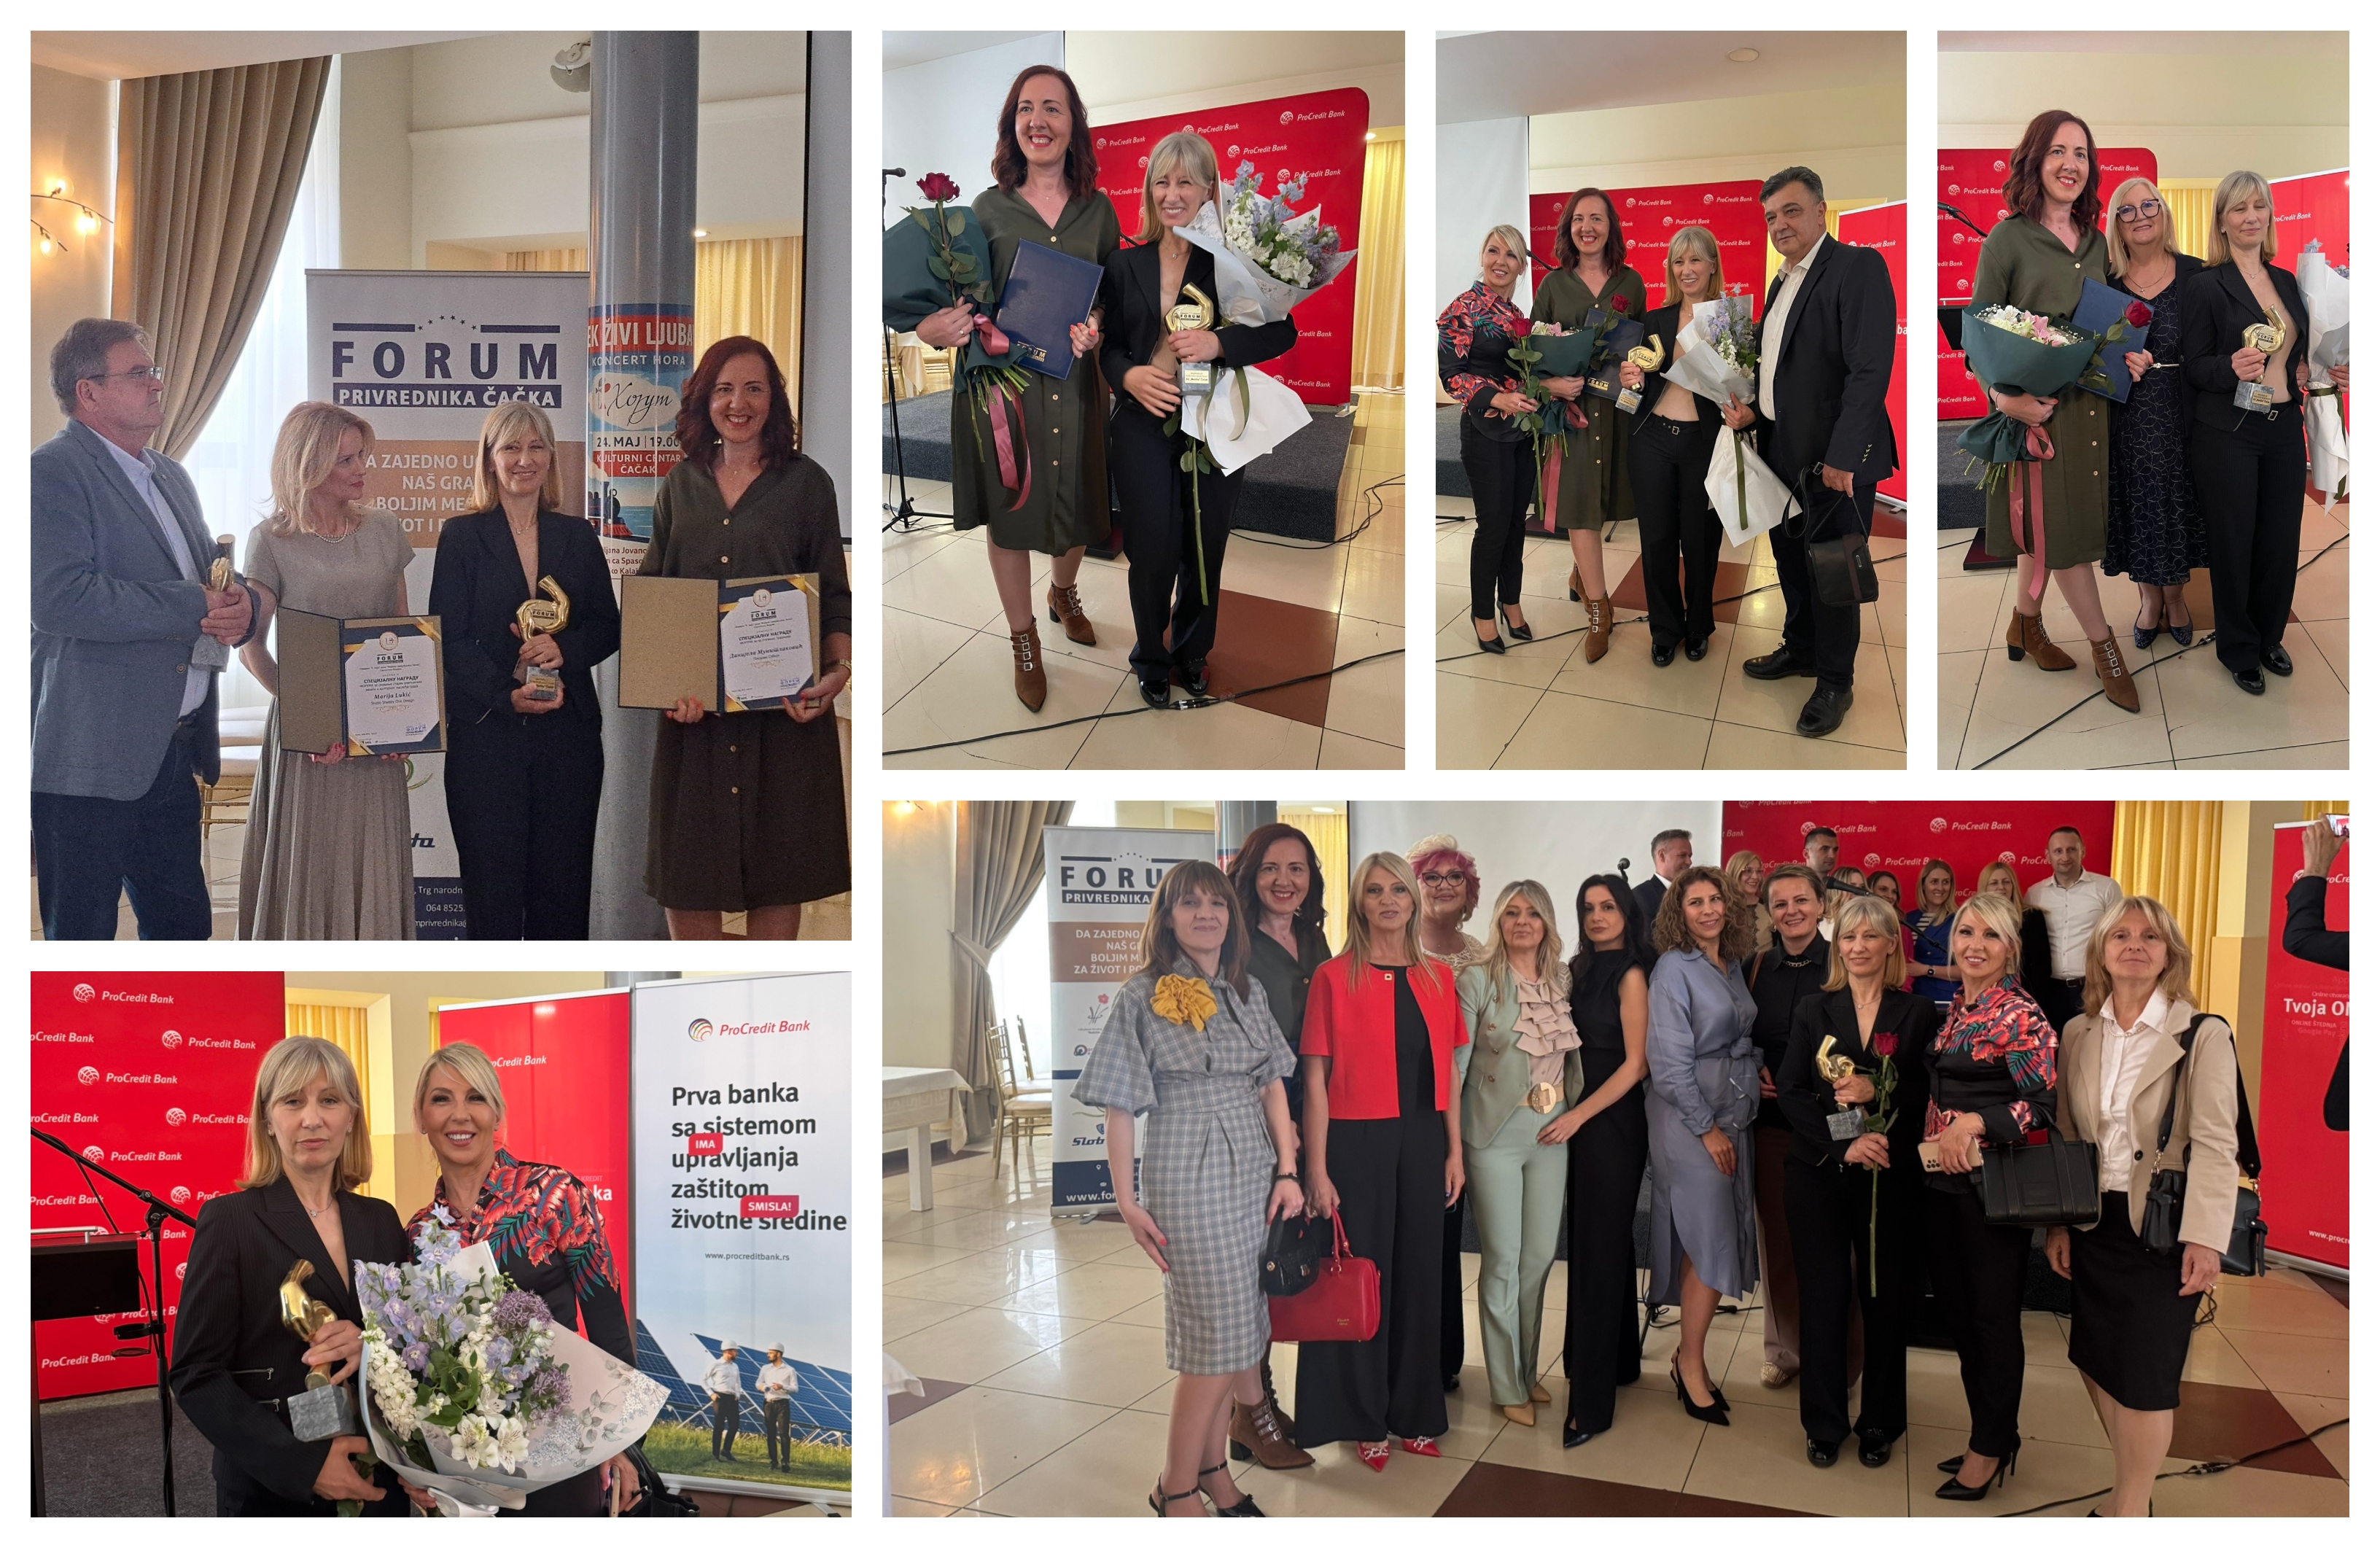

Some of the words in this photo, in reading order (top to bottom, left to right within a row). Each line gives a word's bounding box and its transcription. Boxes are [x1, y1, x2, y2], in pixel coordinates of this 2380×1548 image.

[1297, 111, 1326, 121] ProCredit
[1197, 125, 1223, 133] ProCredit
[1110, 138, 1132, 146] ProCredit
[1243, 147, 1270, 155] ProCredit
[1324, 168, 1341, 176] Bank
[2297, 212, 2311, 220] Bank
[1883, 239, 1896, 247] Bank
[604, 317, 639, 346] ŽIVI
[646, 322, 693, 347] LJUBA
[332, 341, 558, 380] FORUM
[592, 355, 648, 366] KONCERT
[653, 355, 685, 365] HORA
[1288, 379, 1315, 387] ProCredit
[1587, 379, 1609, 387] FORUM
[339, 389, 477, 406] PRIVREDNIKA
[596, 437, 611, 447] 24.
[614, 436, 641, 448] MAJ
[381, 454, 459, 469] ZAJEDNO
[596, 454, 642, 462] KULTURNI
[645, 454, 681, 462] CENTAR
[621, 464, 656, 474] ČAČAK
[402, 472, 435, 490] NAŠ
[440, 475, 475, 491] GRA
[377, 497, 436, 511] BOLJIM
[1857, 824, 1877, 832] Bank
[1951, 822, 1989, 830] ProCredit
[1991, 821, 2012, 829] Bank
[1885, 857, 1921, 866] ProCredit
[1061, 866, 1164, 889] FORU
[418, 886, 432, 895] Trg
[433, 886, 463, 894] narodn
[1065, 892, 1151, 904] PRIVREDNIKA
[1076, 930, 1091, 938] DA
[1093, 930, 1140, 938] ZAJEDNO
[1106, 940, 1127, 950] NAŠ
[1091, 954, 1128, 962] BOLJIM
[1074, 965, 1088, 973] ZA
[1090, 963, 1121, 973] ŽIVOT
[101, 991, 148, 1003] ProCredit
[150, 993, 174, 1004] Bank
[2283, 997, 2327, 1018] Tvoja
[720, 1022, 776, 1036] ProCredit
[778, 1019, 811, 1033] Bank
[31, 1031, 66, 1042] oCredit
[69, 1032, 95, 1043] Bank
[188, 1037, 231, 1049] ProCredit
[233, 1039, 256, 1049] Bank
[524, 1055, 547, 1066] Bank
[106, 1073, 151, 1084] ProCredit
[153, 1074, 178, 1084] Bank
[672, 1086, 722, 1106] Prva
[728, 1081, 799, 1105] banka
[31, 1113, 71, 1123] roCredit
[73, 1113, 99, 1123] Bank
[192, 1114, 235, 1124] ProCredit
[672, 1121, 696, 1137] sa
[702, 1116, 817, 1136] sistemom
[696, 1140, 716, 1149] IMA
[1072, 1137, 1105, 1146] Slob
[110, 1151, 156, 1162] ProCredit
[158, 1151, 182, 1161] Bank
[671, 1178, 769, 1199] zaštitom
[31, 1196, 77, 1205] ProCredit
[748, 1201, 792, 1211] SMISLA!
[671, 1207, 752, 1229] životne
[163, 1229, 187, 1239] Bank
[705, 1251, 790, 1261] www.procreditbank.rs
[42, 1356, 89, 1369] ProCredit
